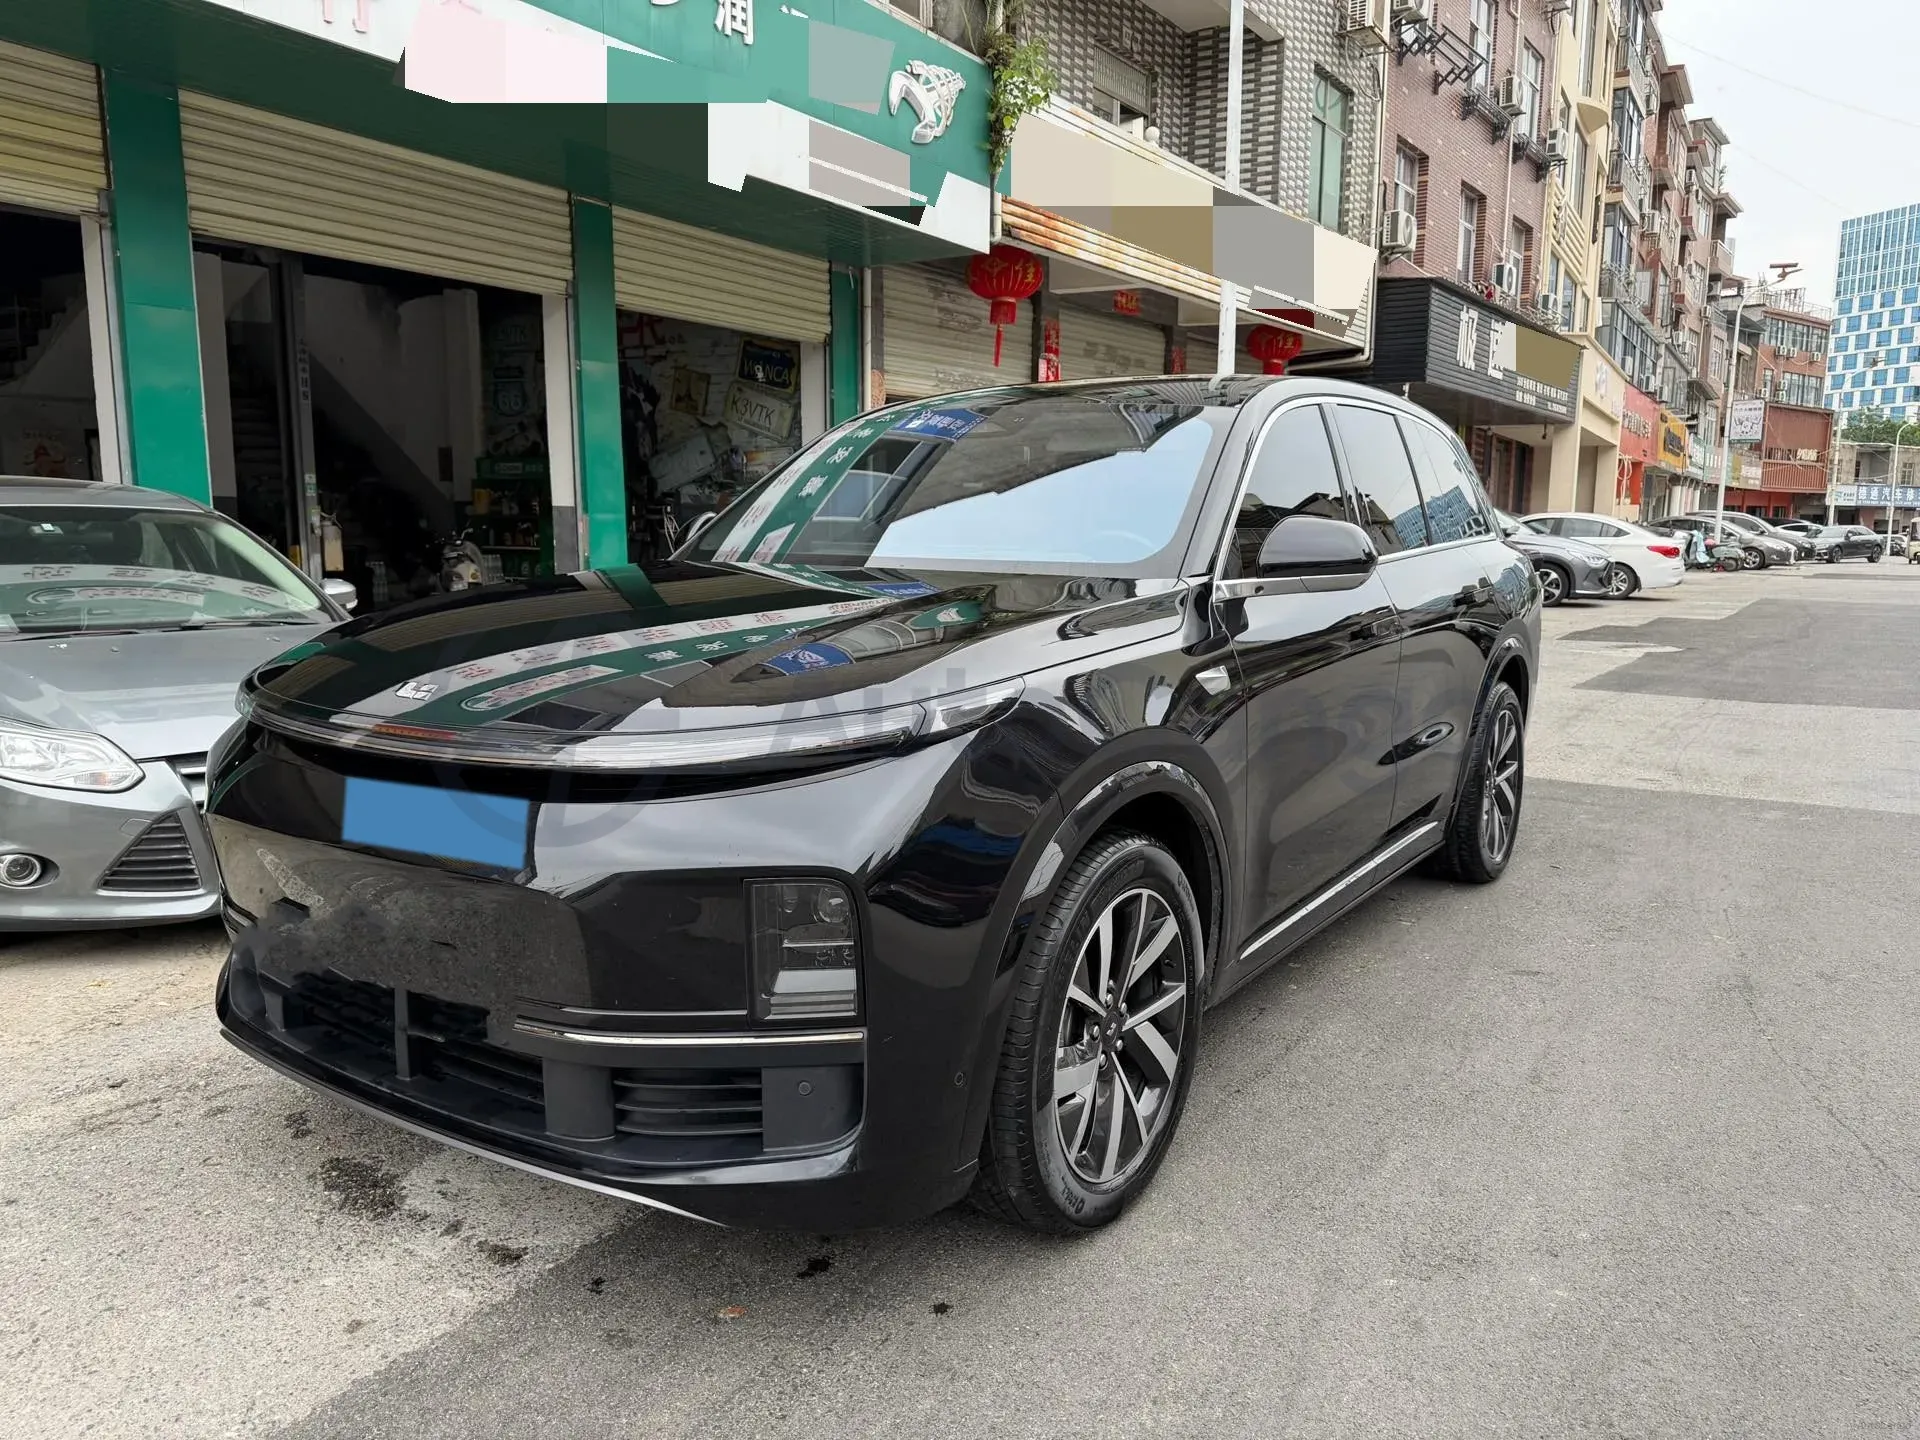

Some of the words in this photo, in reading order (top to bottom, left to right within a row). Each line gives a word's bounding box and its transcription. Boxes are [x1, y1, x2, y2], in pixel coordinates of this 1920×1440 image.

[744, 358, 791, 385] WNCA
[731, 394, 776, 427] K3VTK
[1858, 486, 1920, 502] 德通汽车修
